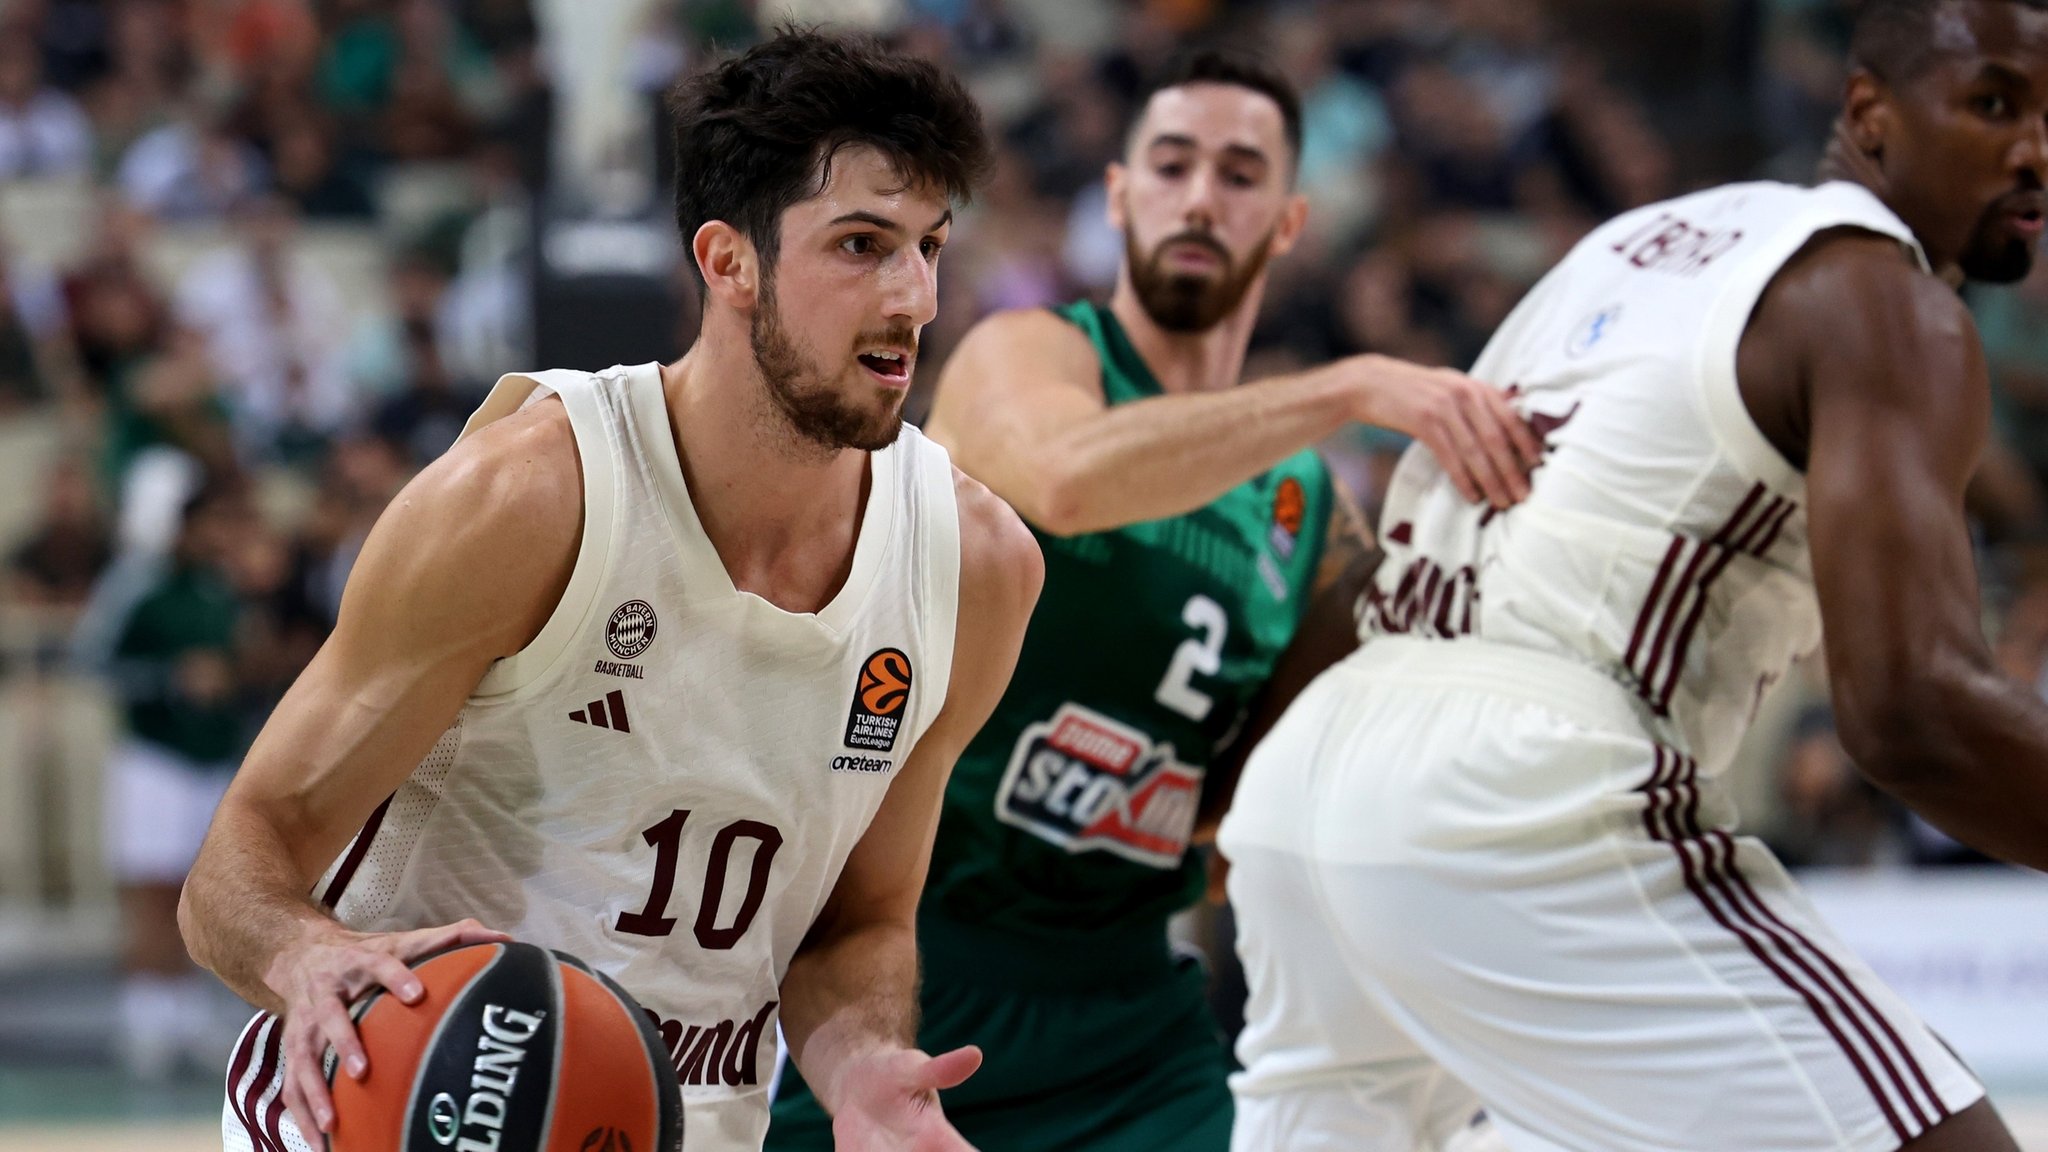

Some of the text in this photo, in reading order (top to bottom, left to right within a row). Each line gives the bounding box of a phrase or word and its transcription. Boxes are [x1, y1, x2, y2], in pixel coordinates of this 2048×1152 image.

[612, 604, 654, 628] FC BAYERN
[1154, 593, 1228, 722] 2
[594, 660, 644, 680] BASKETBALL
[855, 713, 898, 730] TURKISH
[852, 724, 895, 739] AIRLINES
[850, 734, 891, 749] EuroLeague
[832, 754, 893, 773] oneteam
[614, 808, 784, 950] 10
